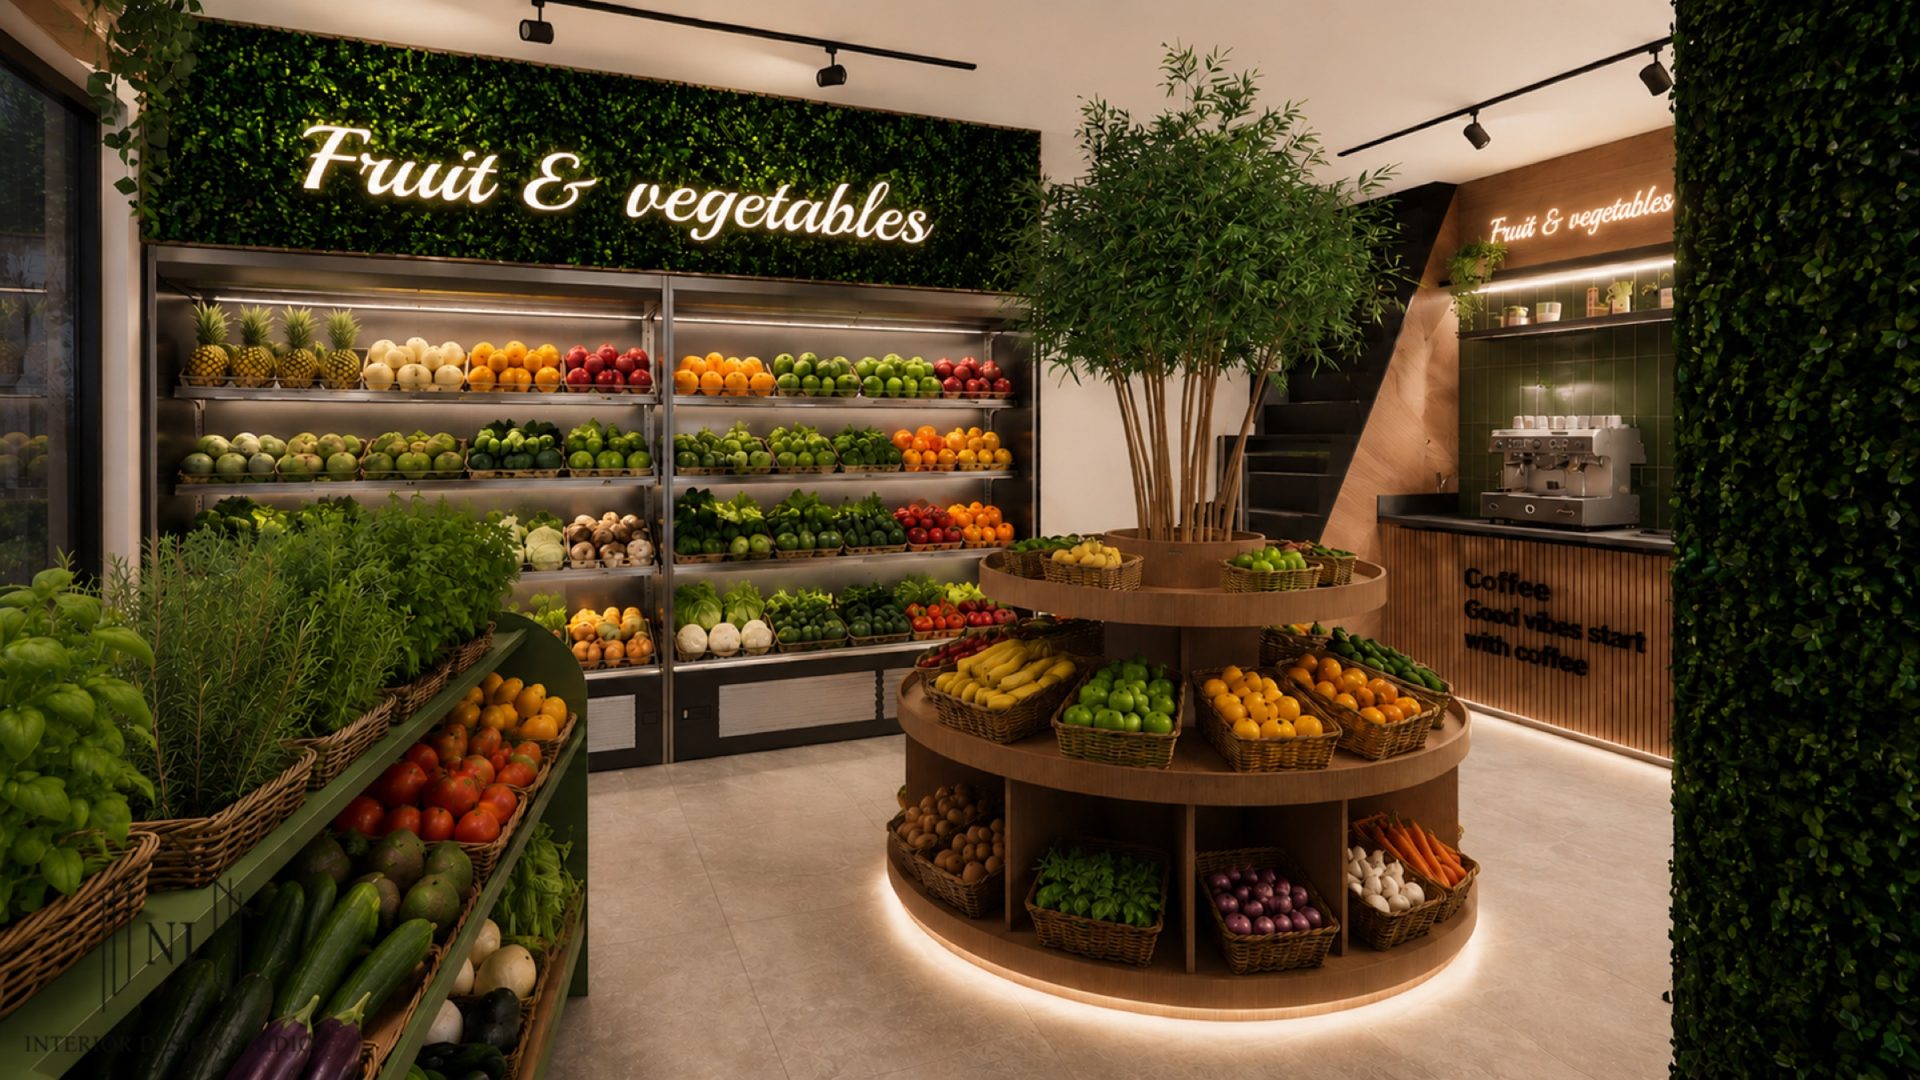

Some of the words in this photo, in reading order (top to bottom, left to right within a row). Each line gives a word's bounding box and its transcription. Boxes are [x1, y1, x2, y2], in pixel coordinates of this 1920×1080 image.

[303, 125, 498, 204] Fruit
[522, 152, 597, 210] &
[625, 181, 934, 243] vegetables
[1490, 215, 1537, 245] Fruit
[1541, 207, 1563, 236] &
[1568, 185, 1675, 236] vegetables
[1464, 567, 1550, 601] Coffee
[1464, 599, 1520, 627] Good
[1523, 611, 1583, 640] vibes
[1588, 625, 1647, 654] start
[1464, 632, 1510, 657] with
[1514, 645, 1589, 676] coffee
